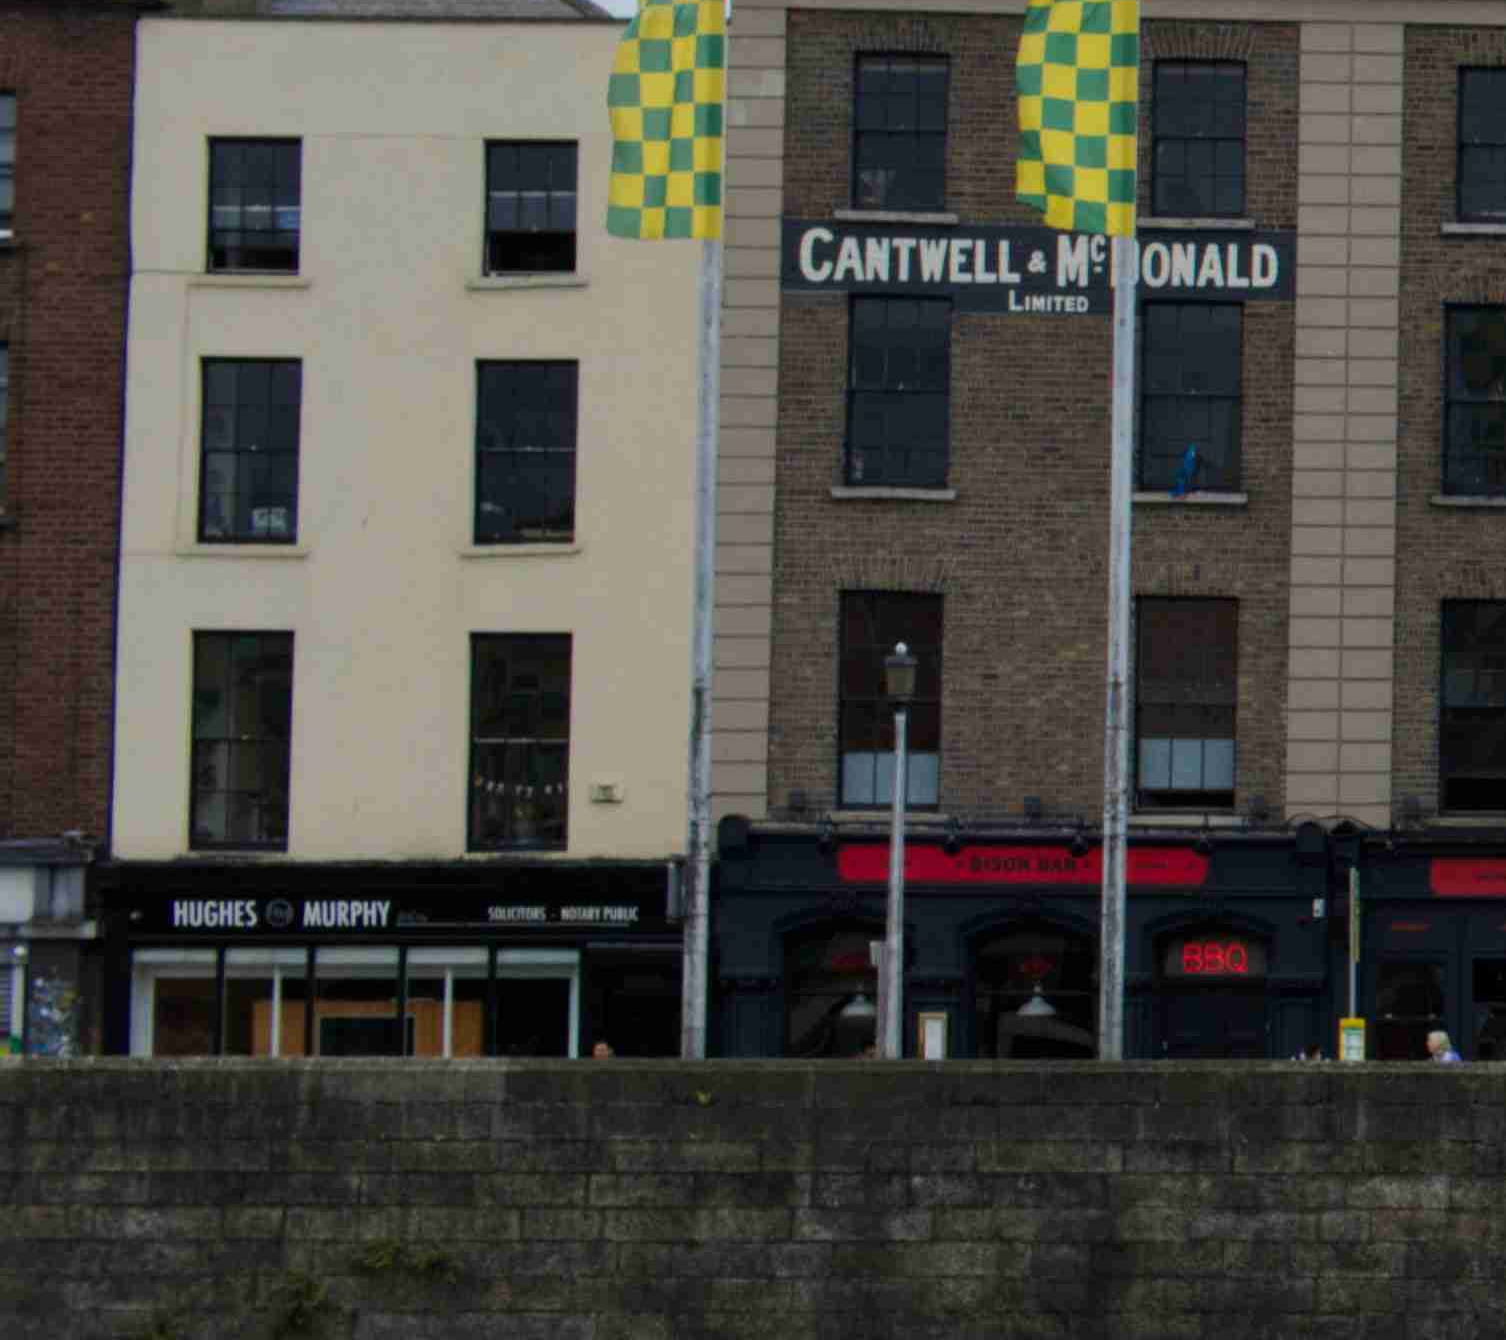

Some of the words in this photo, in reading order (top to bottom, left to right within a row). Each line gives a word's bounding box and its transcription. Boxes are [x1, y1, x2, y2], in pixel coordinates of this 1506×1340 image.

[799, 227, 1021, 284] CANTWELL
[1027, 250, 1048, 273] &
[1008, 288, 1090, 313] LIMITED
[172, 900, 258, 927] HUGHES
[302, 900, 391, 927] MURPHY
[487, 905, 547, 922] SOLICITORS
[560, 905, 601, 922] NOTARY
[602, 905, 640, 922] PUBLIC
[1182, 941, 1248, 974] BBQ
